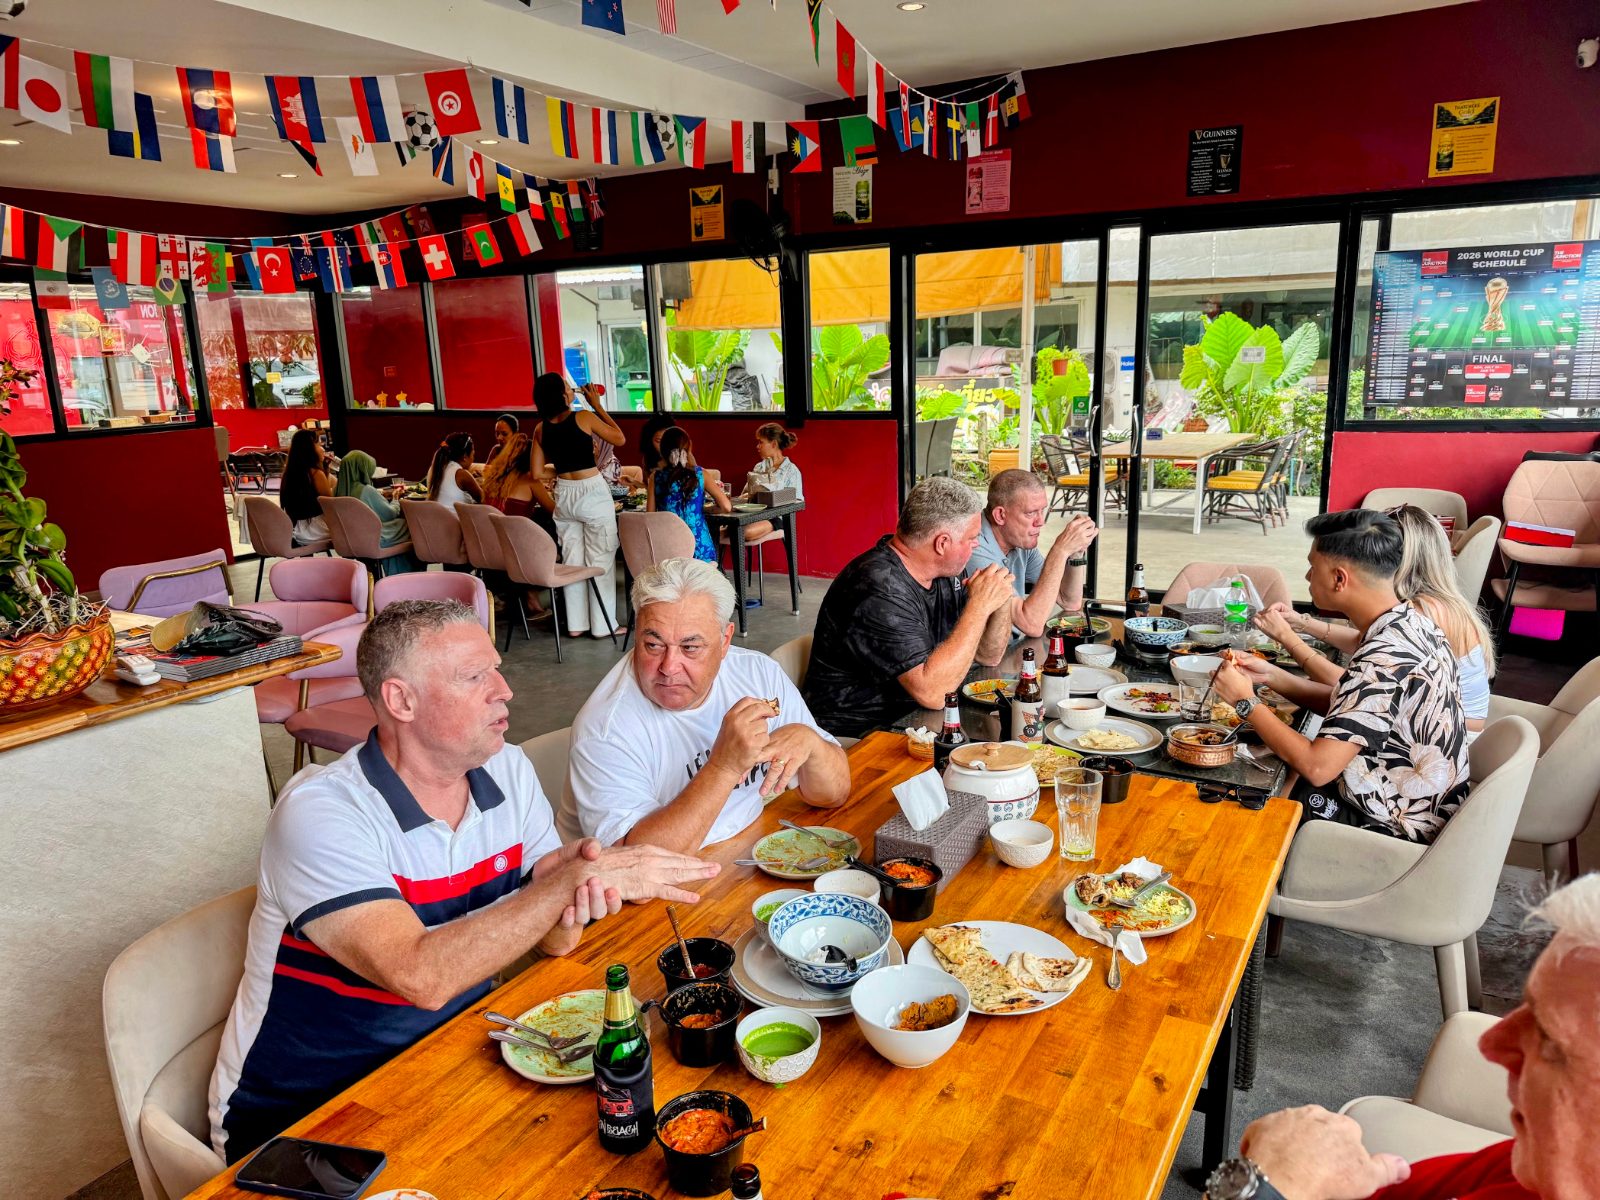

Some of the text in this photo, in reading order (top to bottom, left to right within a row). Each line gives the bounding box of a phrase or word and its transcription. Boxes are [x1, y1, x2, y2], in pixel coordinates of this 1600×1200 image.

[1203, 129, 1237, 138] GUINNESS
[1457, 248, 1545, 260] 2026 WORLD CUP
[1472, 259, 1527, 269] SCHEDULE
[1472, 354, 1506, 363] FINAL
